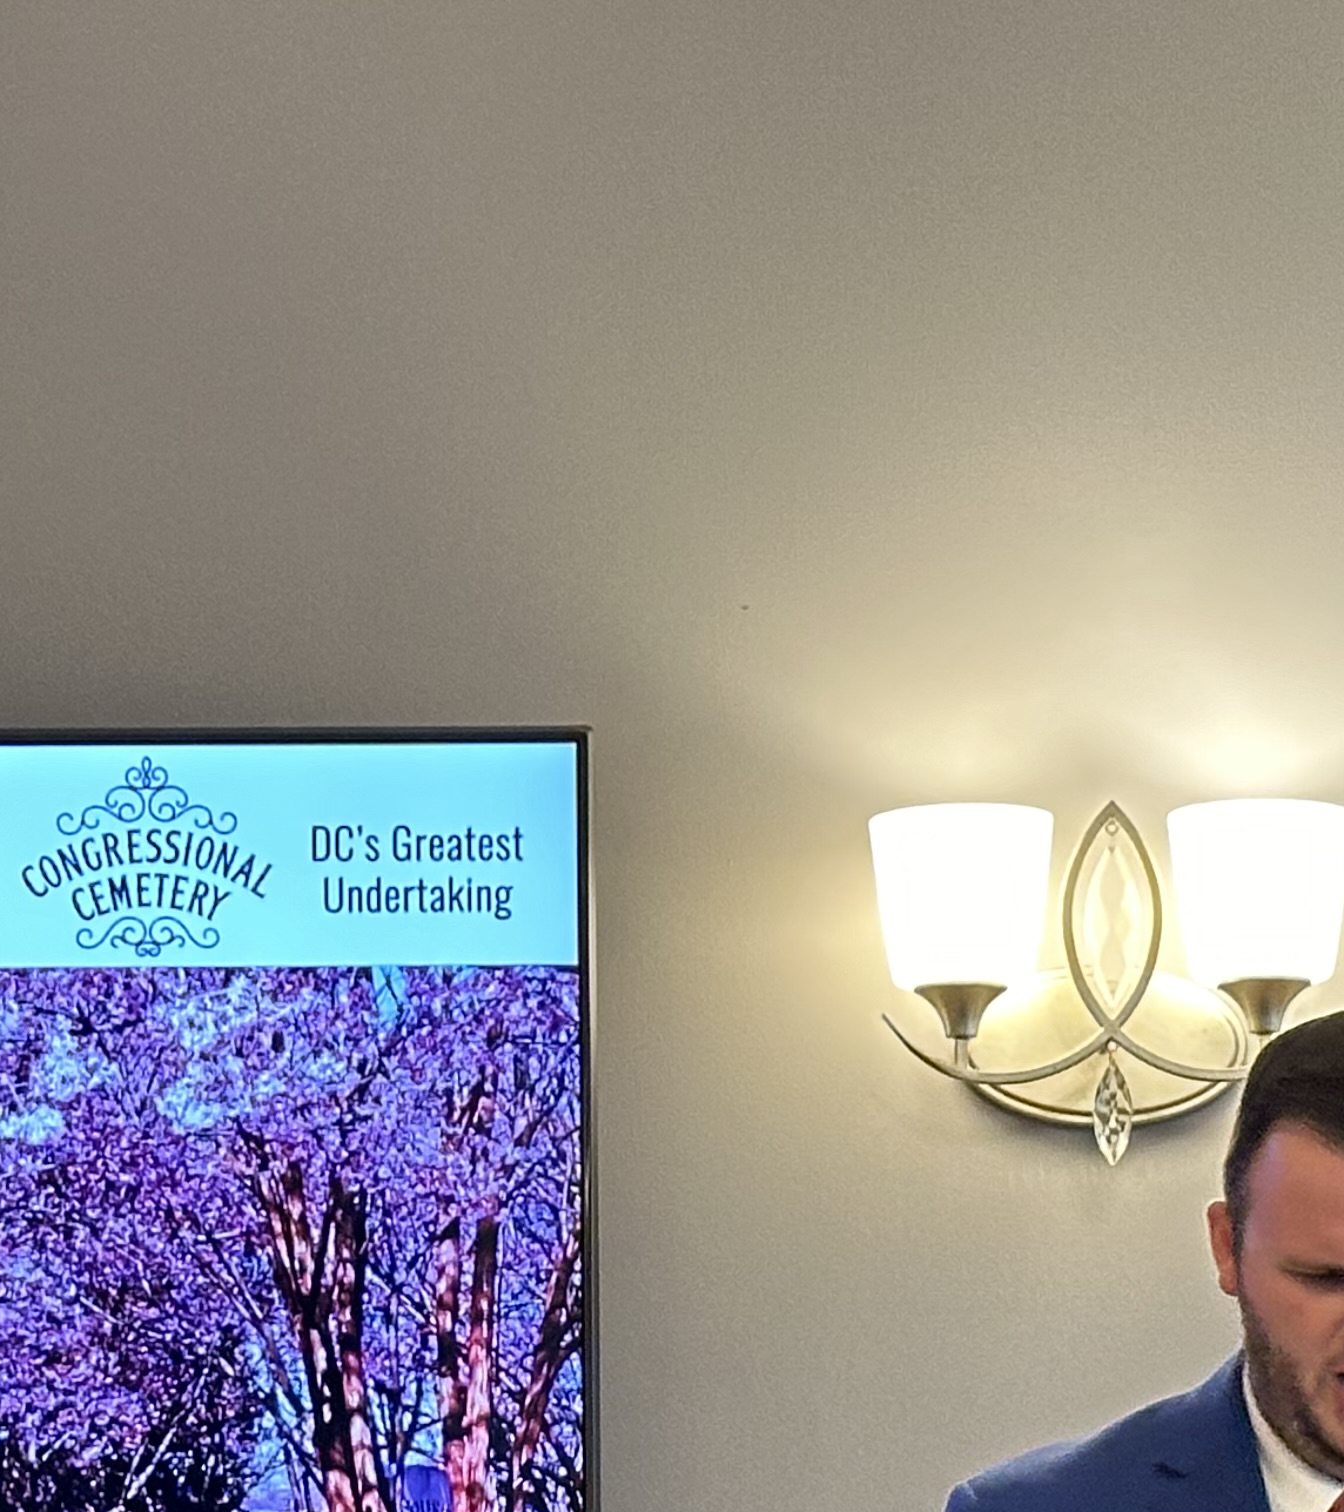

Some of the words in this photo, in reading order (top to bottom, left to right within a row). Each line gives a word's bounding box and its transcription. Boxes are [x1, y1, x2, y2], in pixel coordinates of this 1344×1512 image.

[21, 828, 273, 899] CONGRESSIONAL
[311, 825, 380, 863] DC's
[393, 825, 523, 863] Greatest
[71, 872, 231, 921] CEMETERY
[323, 876, 514, 921] Undertaking
